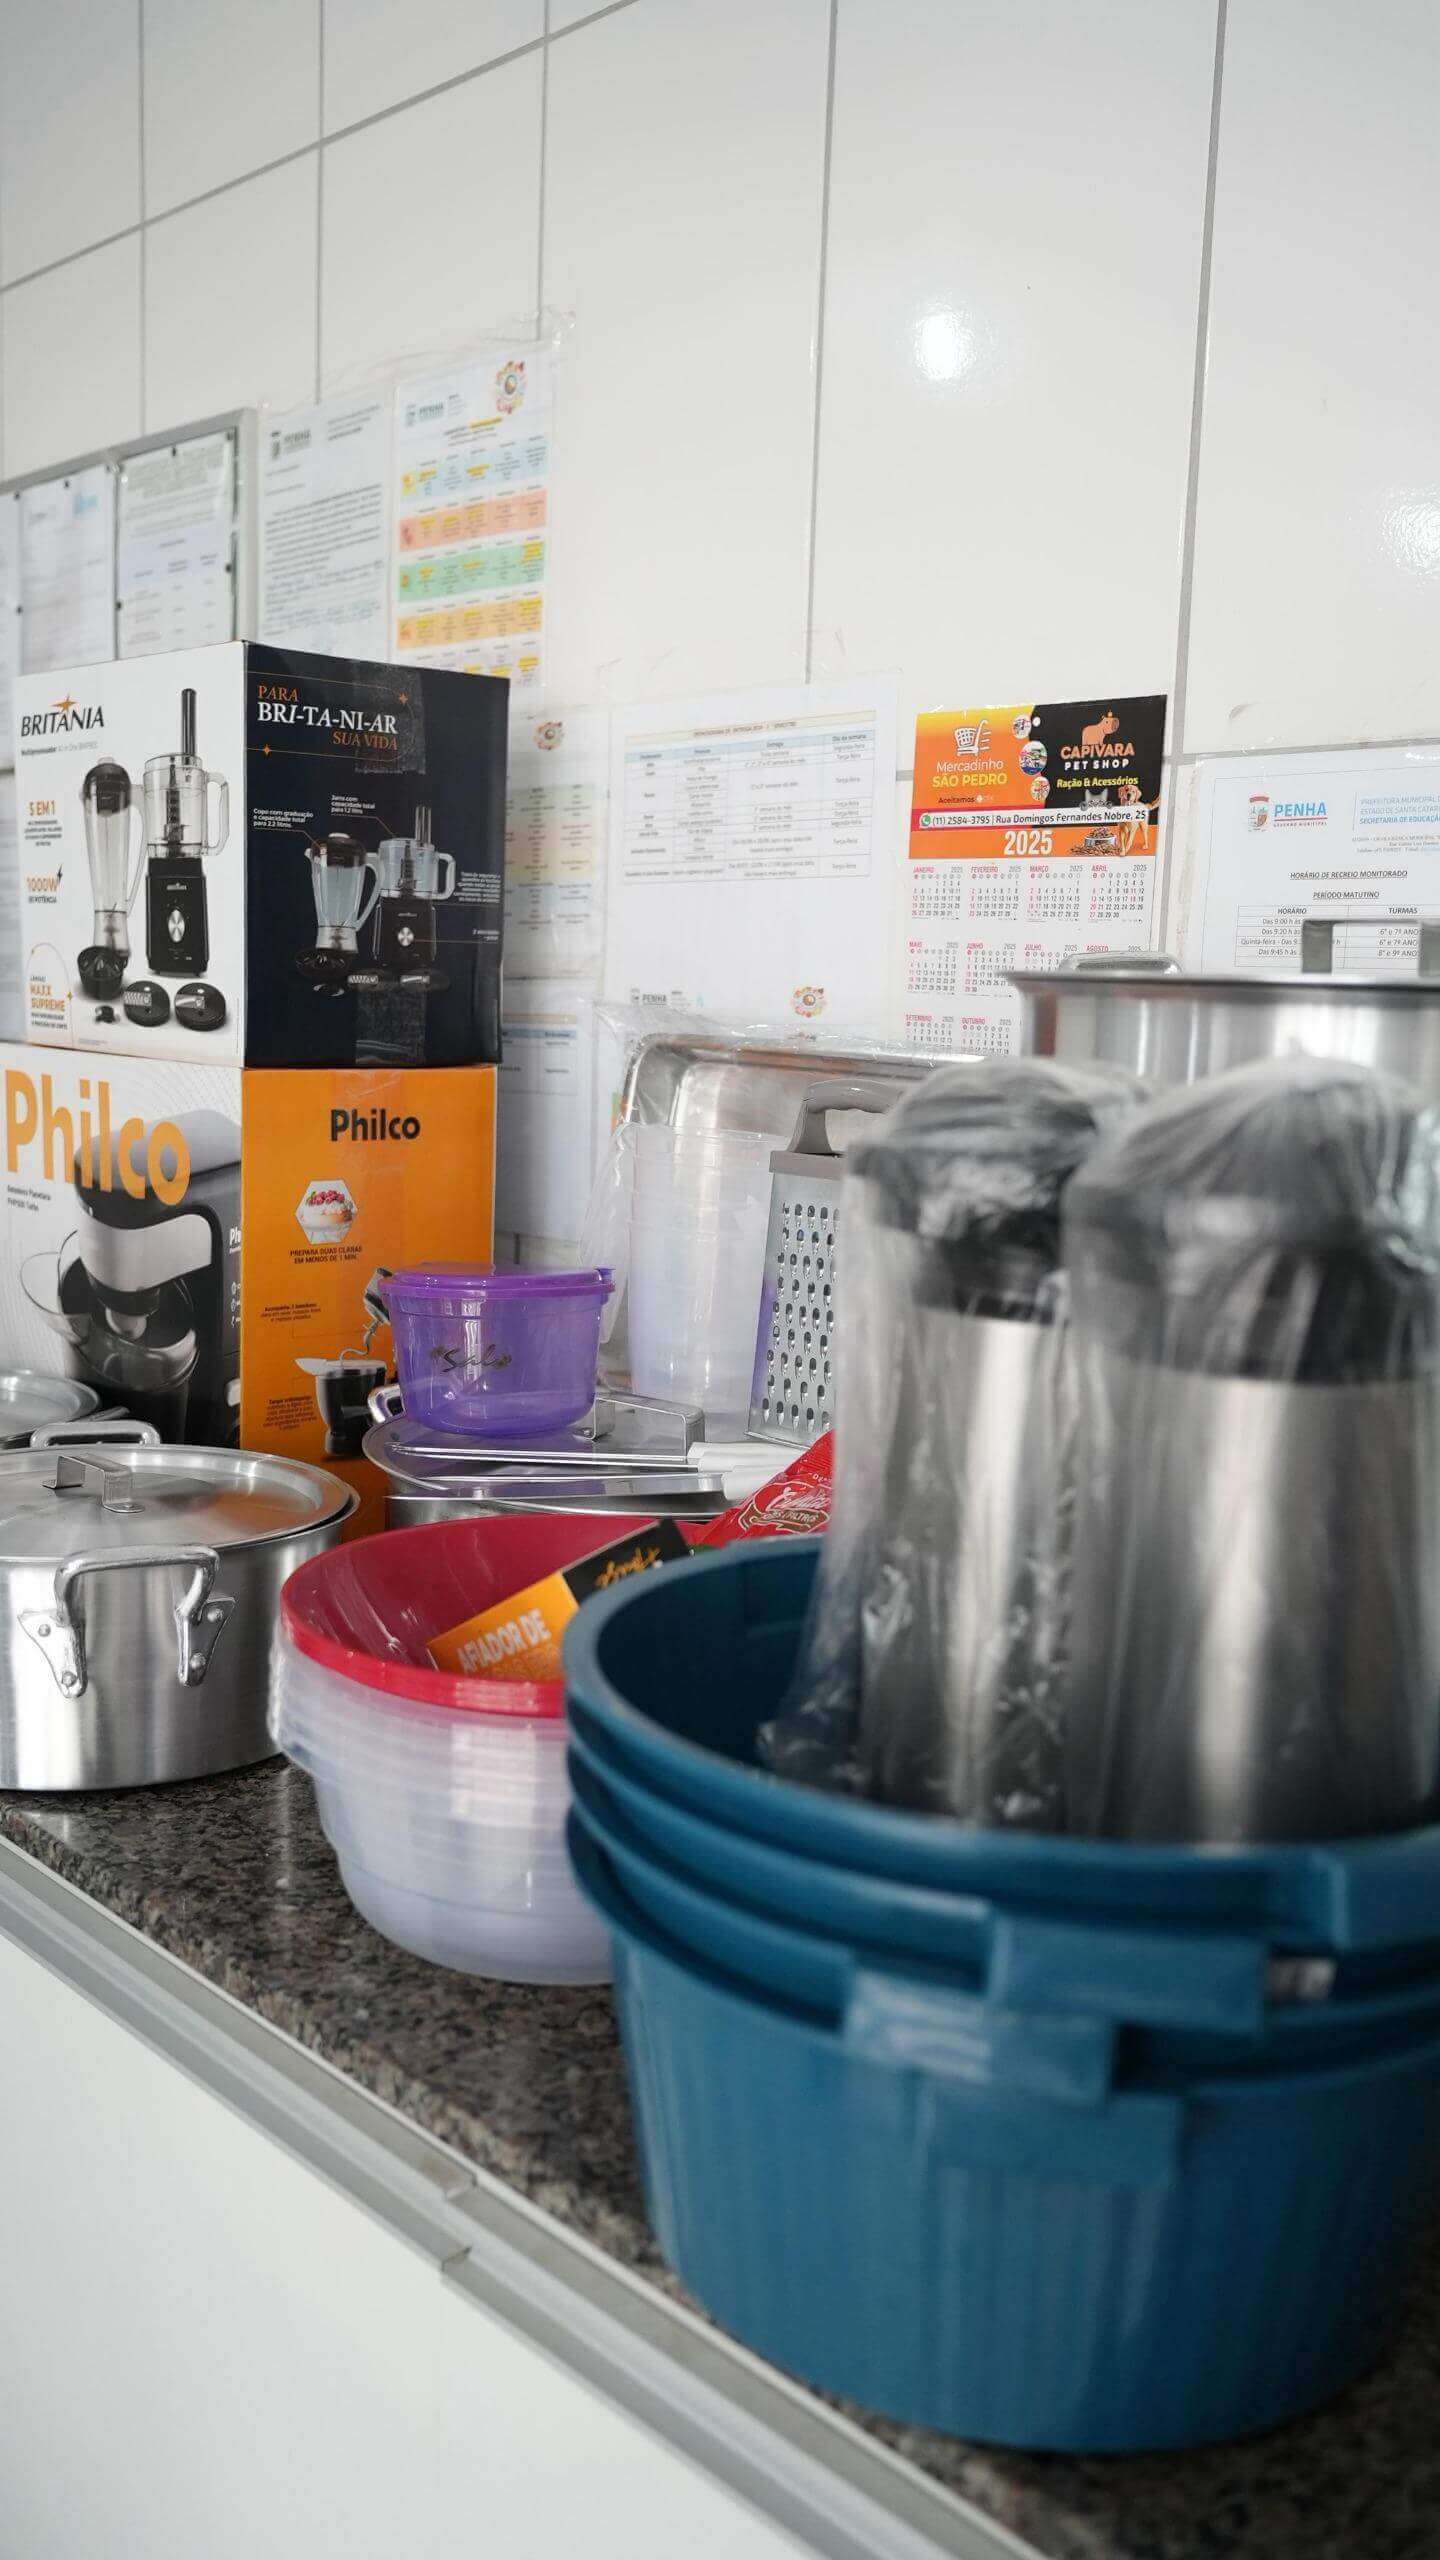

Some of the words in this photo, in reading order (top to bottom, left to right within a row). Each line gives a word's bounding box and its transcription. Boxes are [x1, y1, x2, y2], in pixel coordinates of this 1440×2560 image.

[258, 685, 299, 702] PARA
[257, 701, 399, 734] BRI-TA-NI-AR
[332, 731, 361, 747] SUA
[364, 734, 397, 750] VIDA
[1061, 743, 1135, 760] CAPIVARA
[936, 758, 1004, 773] Mercadinho
[1064, 760, 1089, 771] PET
[1093, 759, 1129, 770] SHOP
[932, 774, 959, 788] SÃO
[962, 773, 1008, 787] PEDRO
[1057, 778, 1082, 790] Ração
[1092, 776, 1139, 787] Acessórios
[932, 816, 946, 826] (11)
[947, 816, 990, 825] 2584-3795
[996, 815, 1011, 823] Rua
[1014, 813, 1055, 825] Domingos
[1057, 812, 1102, 822] Fernandes
[1136, 810, 1146, 819] 25
[1274, 801, 1328, 818] PENHA
[1004, 830, 1053, 855] 2025
[1321, 871, 1330, 880] DE
[1359, 869, 1408, 879] MONITORADO
[27, 875, 59, 892] 1000W
[1343, 890, 1380, 899] MATUTINO
[1388, 907, 1418, 915] TURMAS
[330, 1108, 421, 1142] Philco
[5, 1069, 191, 1206] Philco
[457, 1620, 528, 1676] AFIADOR
[518, 1608, 552, 1648] DE
